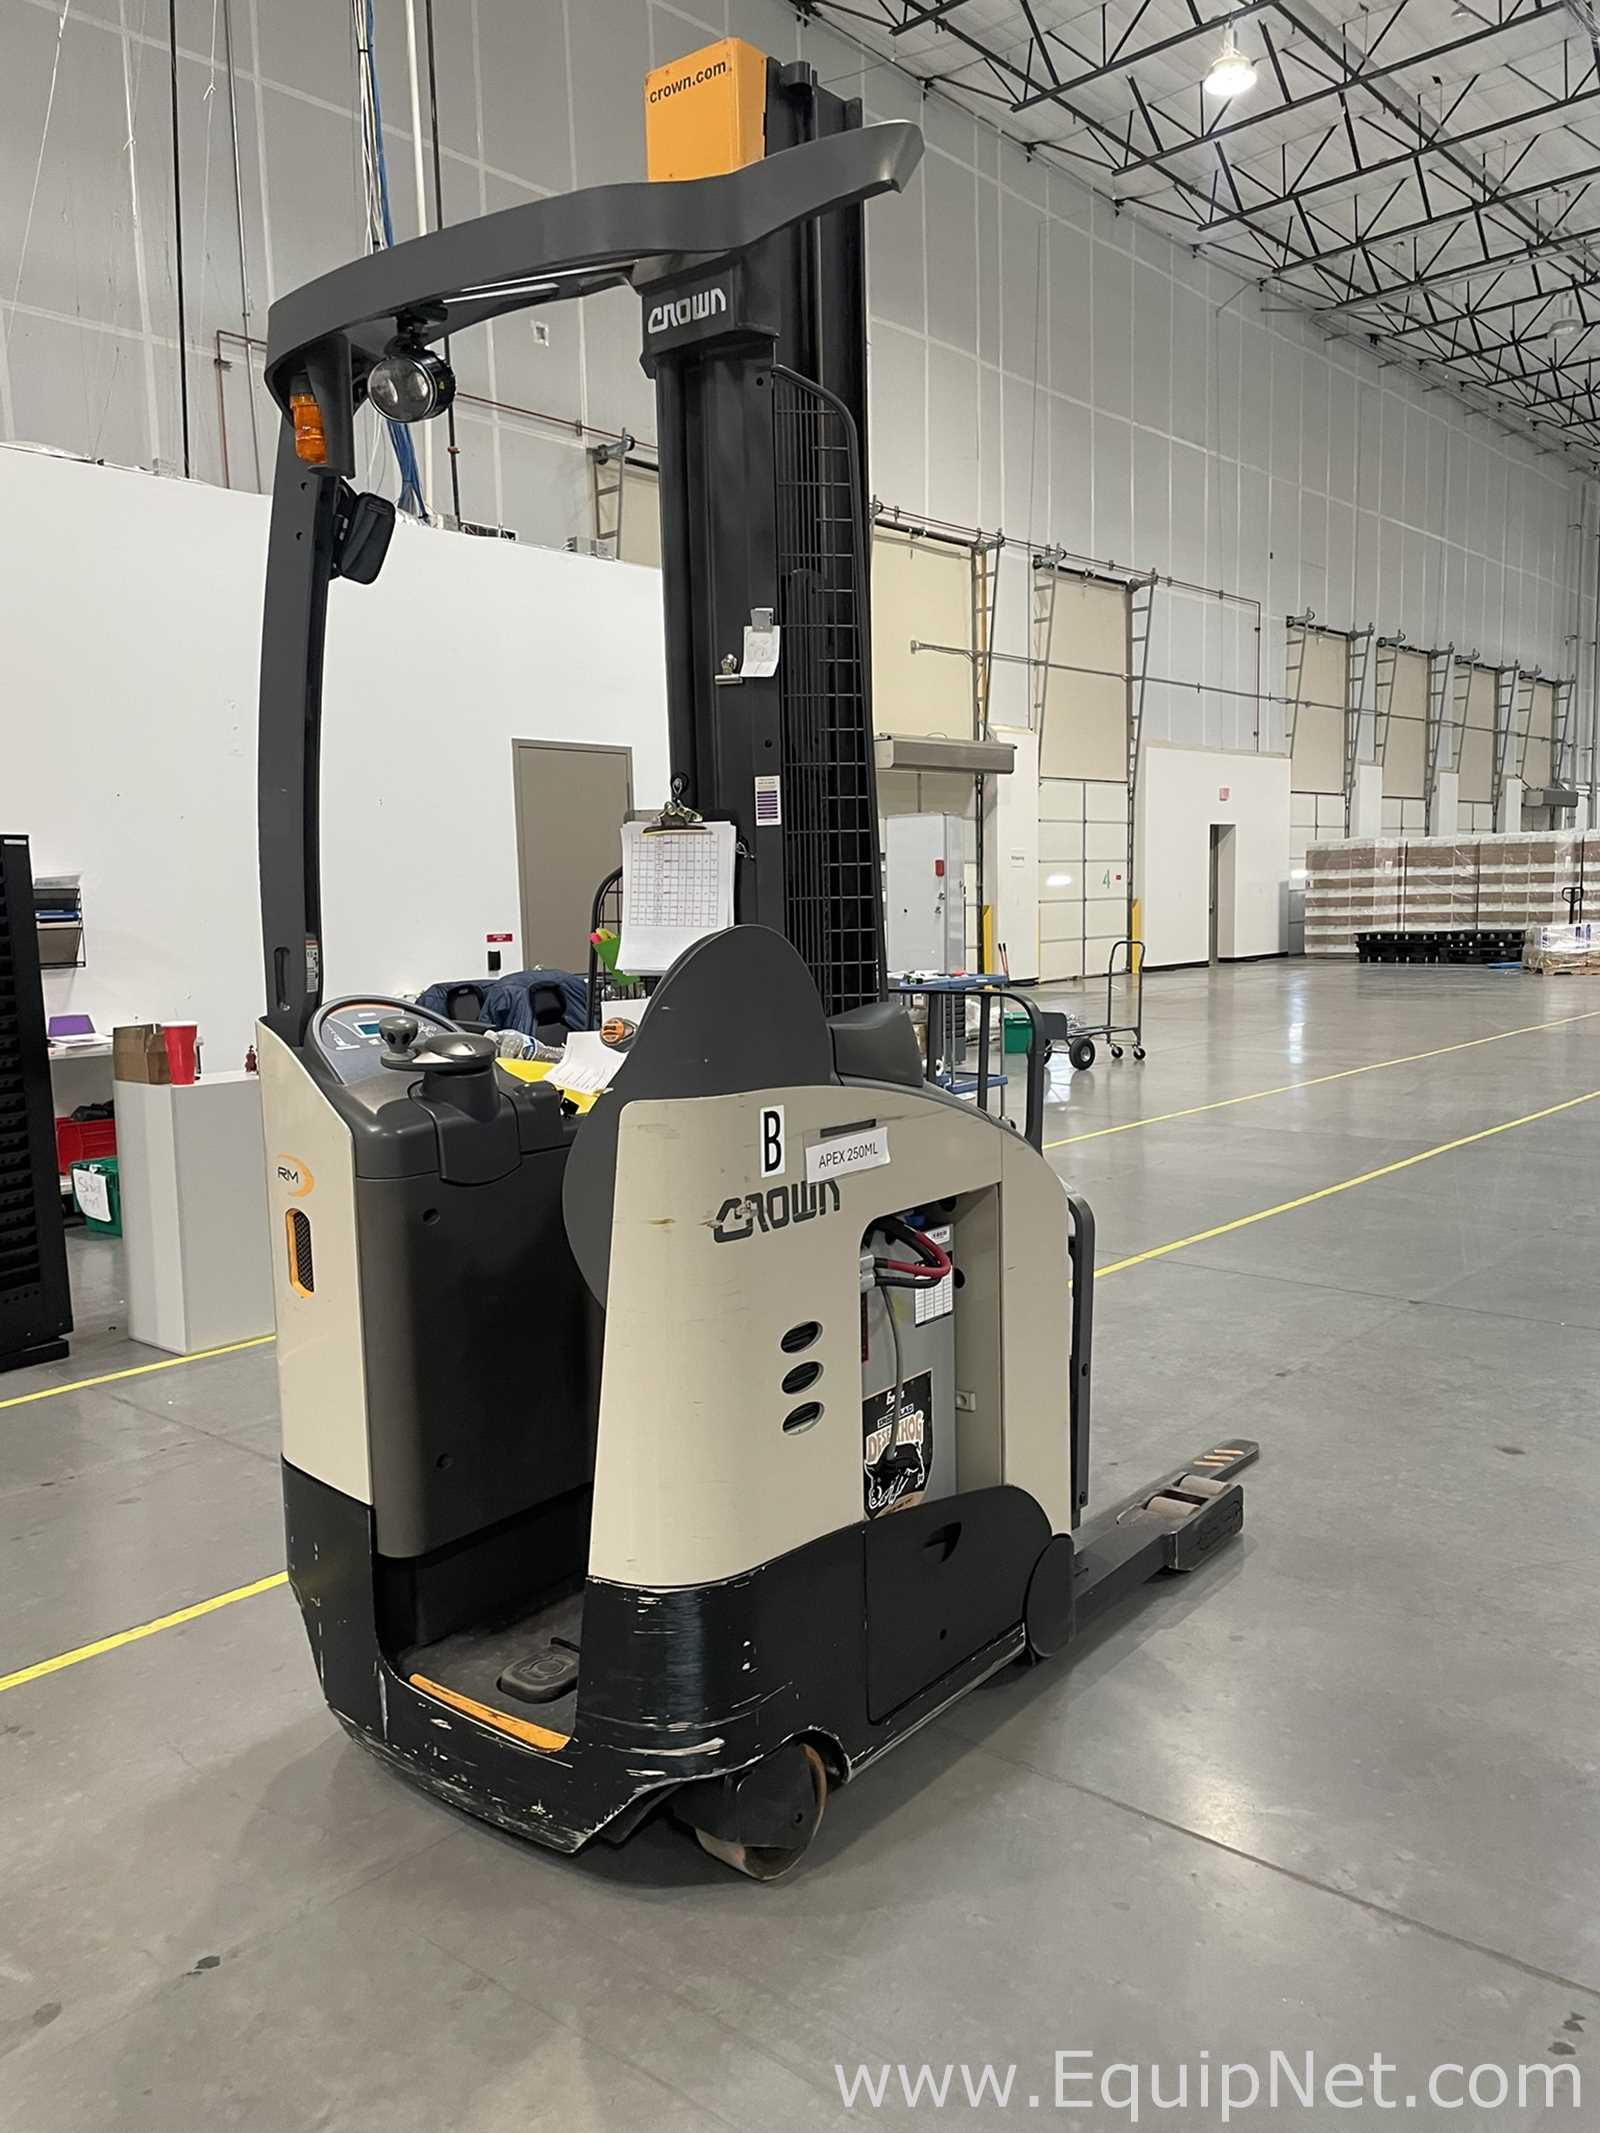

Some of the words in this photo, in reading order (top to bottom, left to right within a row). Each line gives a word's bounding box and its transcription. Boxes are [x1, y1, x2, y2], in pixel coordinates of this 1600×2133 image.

[650, 61, 726, 103] crown.com
[648, 287, 726, 334] CROWN
[763, 1110, 782, 1173] B
[819, 1152, 846, 1169] APEX
[847, 1142, 879, 1162] 250ML
[277, 1166, 299, 1184] RM
